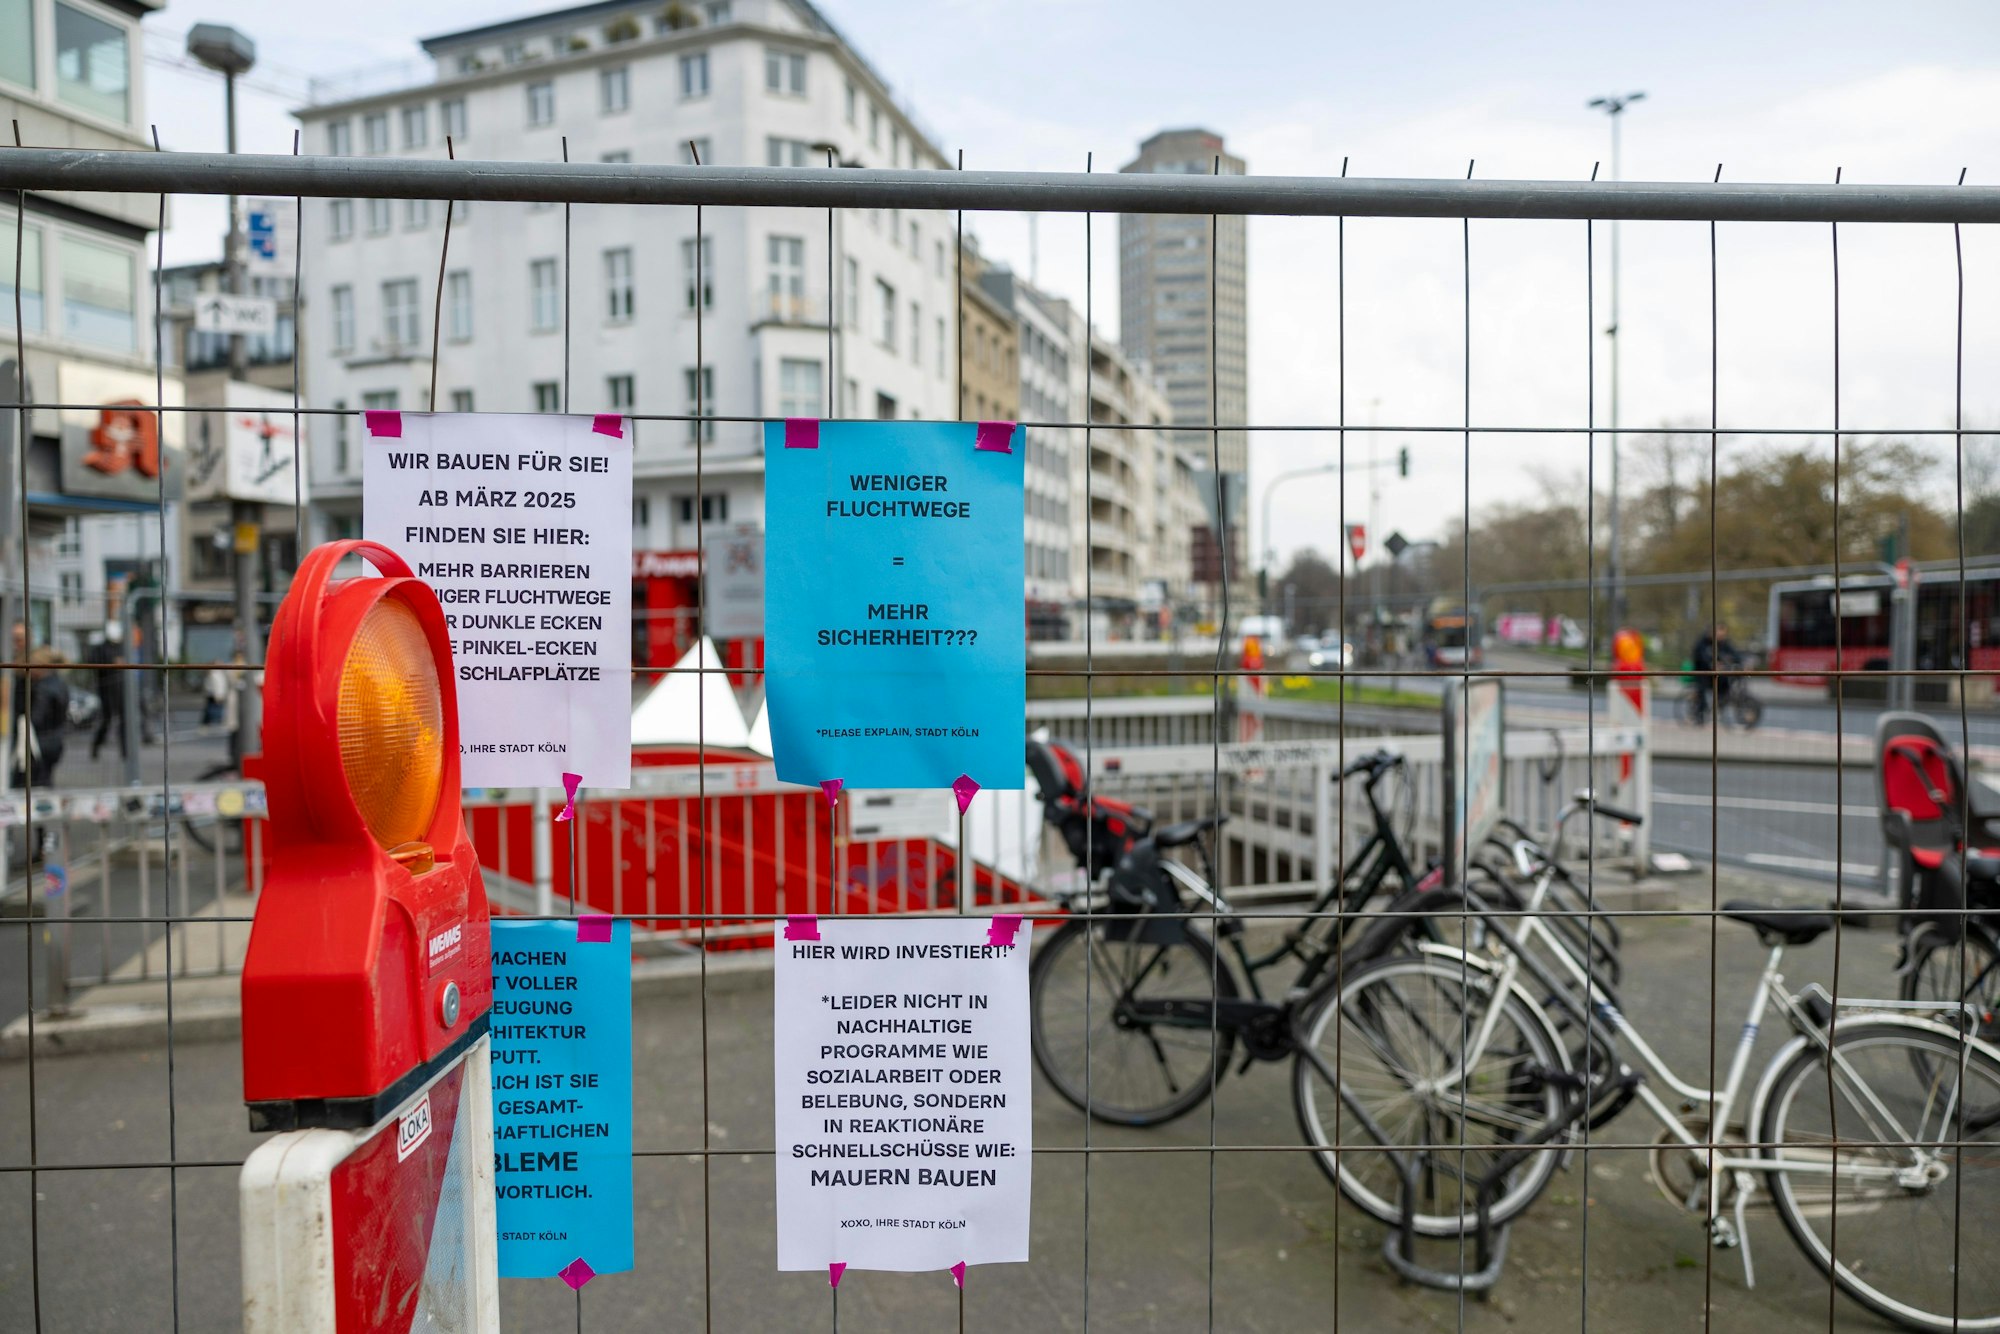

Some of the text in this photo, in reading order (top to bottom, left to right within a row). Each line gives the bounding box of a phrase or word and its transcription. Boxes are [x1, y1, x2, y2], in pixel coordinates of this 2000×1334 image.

[388, 451, 608, 473] WIR BAUEN FÜR SIE!
[850, 475, 947, 491] WENIGER
[419, 486, 575, 508] AB MÄRZ 2025
[827, 501, 969, 517] FLUCHTWEGE
[406, 527, 589, 545] FINDEN SIE HIER:
[418, 563, 589, 578] MEHR BARRIEREN
[435, 588, 610, 604] IGER FLUCHTWEGE
[869, 604, 928, 619] MEHR
[463, 615, 535, 629] DUNKLE
[541, 616, 601, 630] ECKEN
[818, 630, 977, 645] SICHERHEIT???
[463, 641, 596, 655] PINKEL-ECKEN
[460, 664, 601, 681] SCHLAFPLÄTZE
[864, 727, 913, 738] EXPLAIN,
[914, 727, 949, 737] STADT
[951, 726, 979, 737] KÖLN
[470, 744, 496, 753] IHRE
[499, 744, 535, 753] STADT
[538, 741, 566, 753] KÖLN
[793, 945, 835, 959] HIER
[841, 946, 890, 959] WIRD
[506, 976, 577, 990] VOLLER
[489, 1001, 572, 1015] EUGUNG
[904, 994, 962, 1008] NICHT
[970, 995, 987, 1009] IN
[489, 1025, 586, 1039] HITEKTUR
[838, 1020, 971, 1034] NACHHALTIGE
[491, 1050, 540, 1065] PUTT.
[822, 1045, 987, 1059] PROGRAMME WIE
[536, 1075, 564, 1089] IST
[570, 1074, 598, 1088] SIE
[807, 1069, 1001, 1084] SOZIALARBEIT ODER
[499, 1100, 583, 1115] GESAMT-
[802, 1094, 1005, 1110] BELEBUNG, SONDERN
[401, 1107, 429, 1145] LÖKA
[494, 1123, 608, 1139] HAFTLICHEN
[825, 1115, 983, 1133] IN REAKTIONÄRE
[793, 1139, 1014, 1158] SCHNELLSCHÜSSE WIE:
[495, 1152, 578, 1172] BLEME
[812, 1169, 995, 1187] MAUERN BAUEN
[496, 1184, 592, 1199] WORTLICH.
[840, 1218, 966, 1230] XOXO, IHRE STADT KÖLN
[501, 1231, 536, 1241] STADT
[538, 1230, 568, 1241] KÖLN
